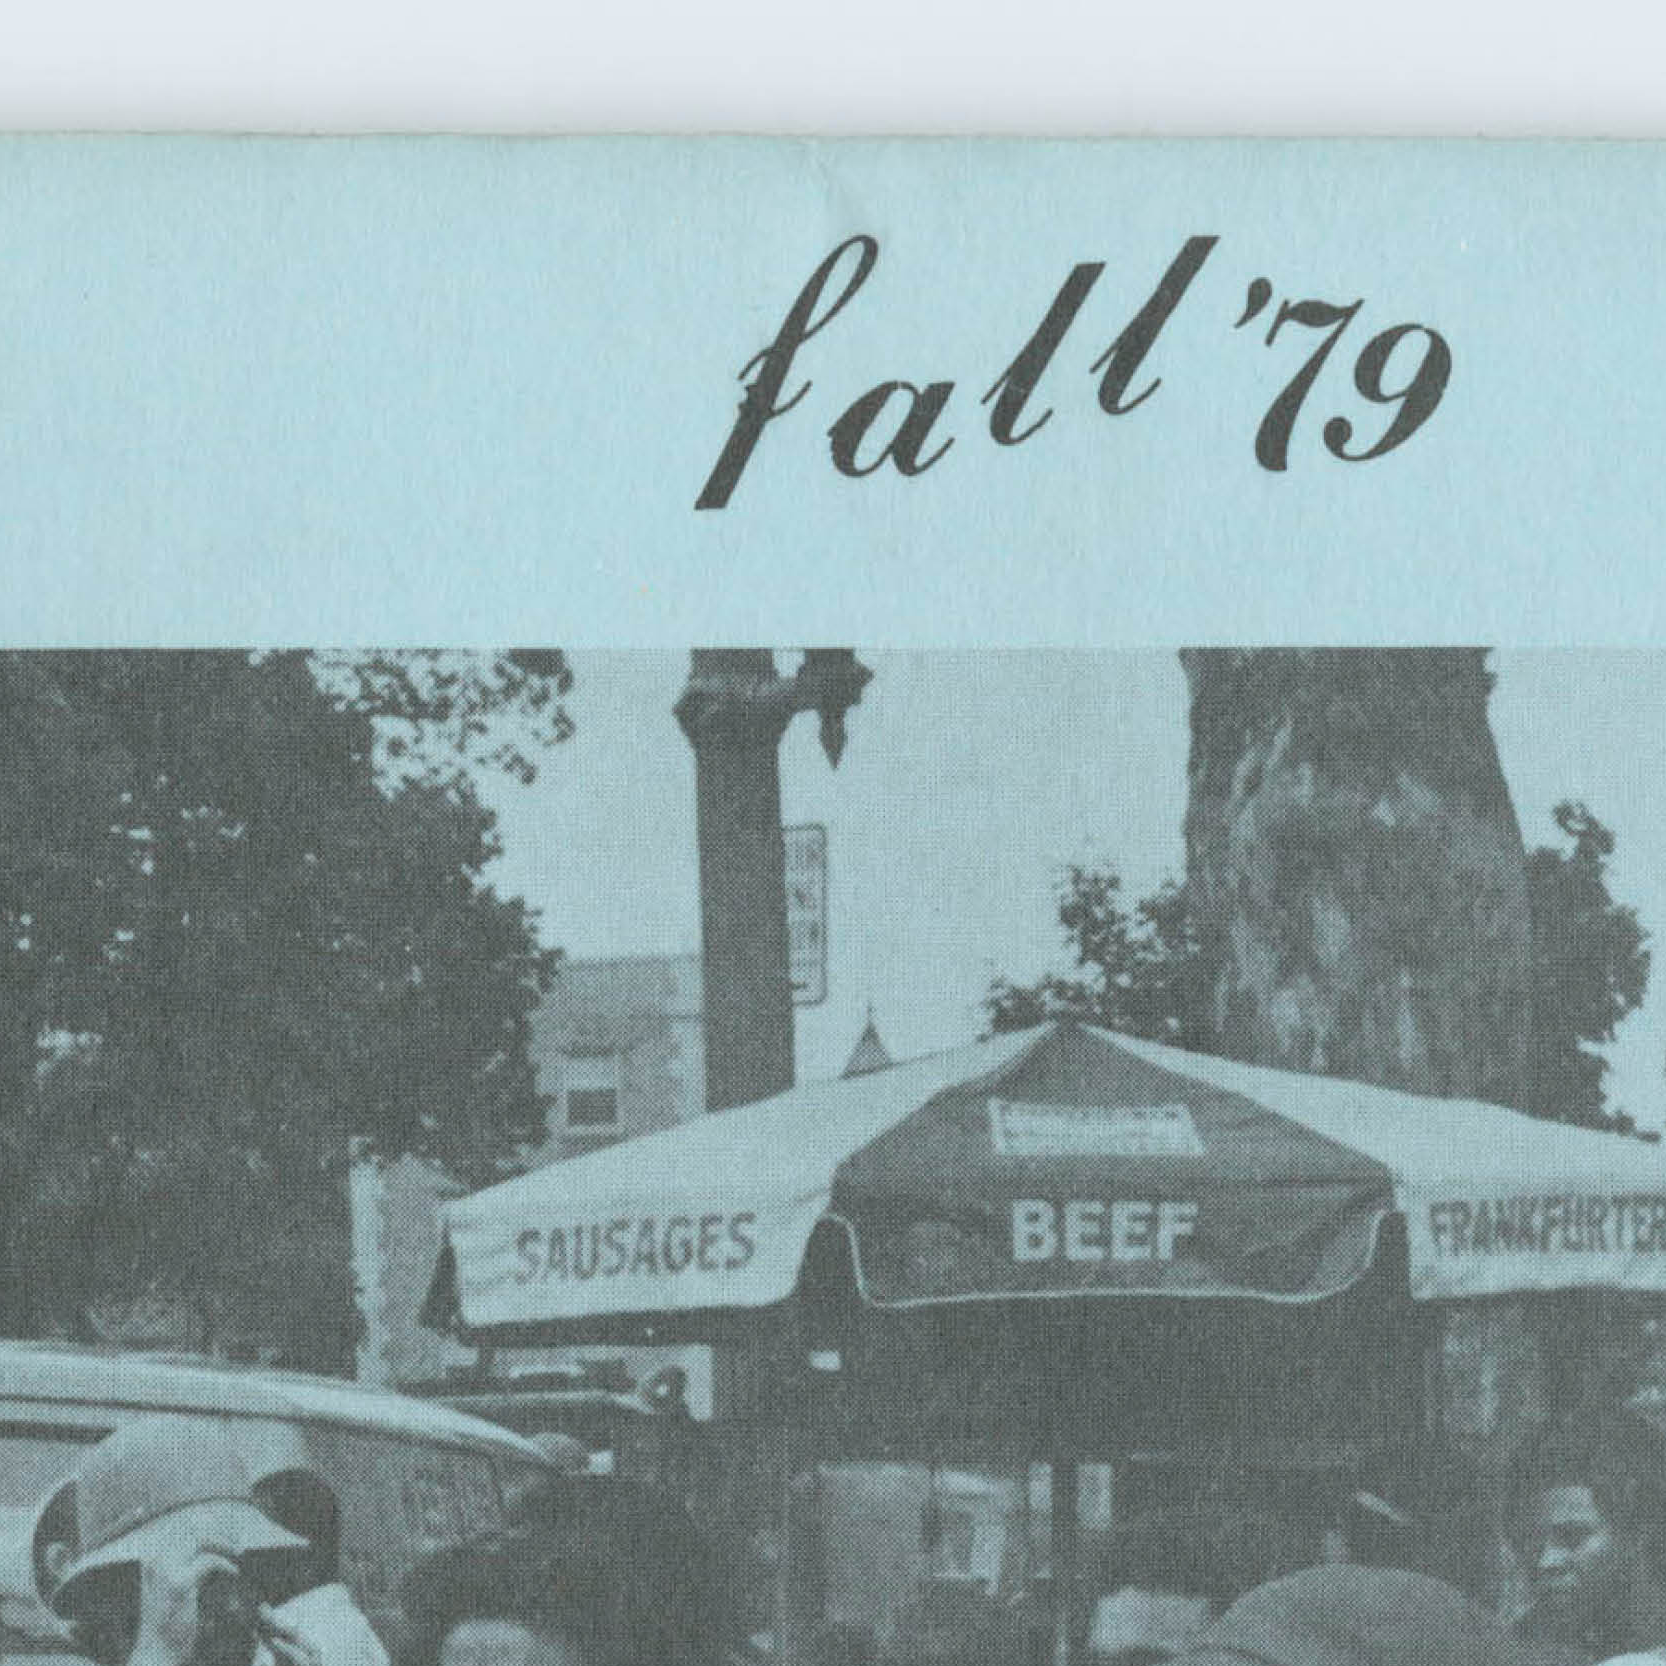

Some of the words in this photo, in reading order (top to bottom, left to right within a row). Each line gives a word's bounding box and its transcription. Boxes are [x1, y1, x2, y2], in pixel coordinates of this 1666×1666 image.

[693, 233, 1220, 512] fall
[513, 1211, 757, 1286] SAUSAGES
[1012, 1199, 1200, 1262] BEEF
